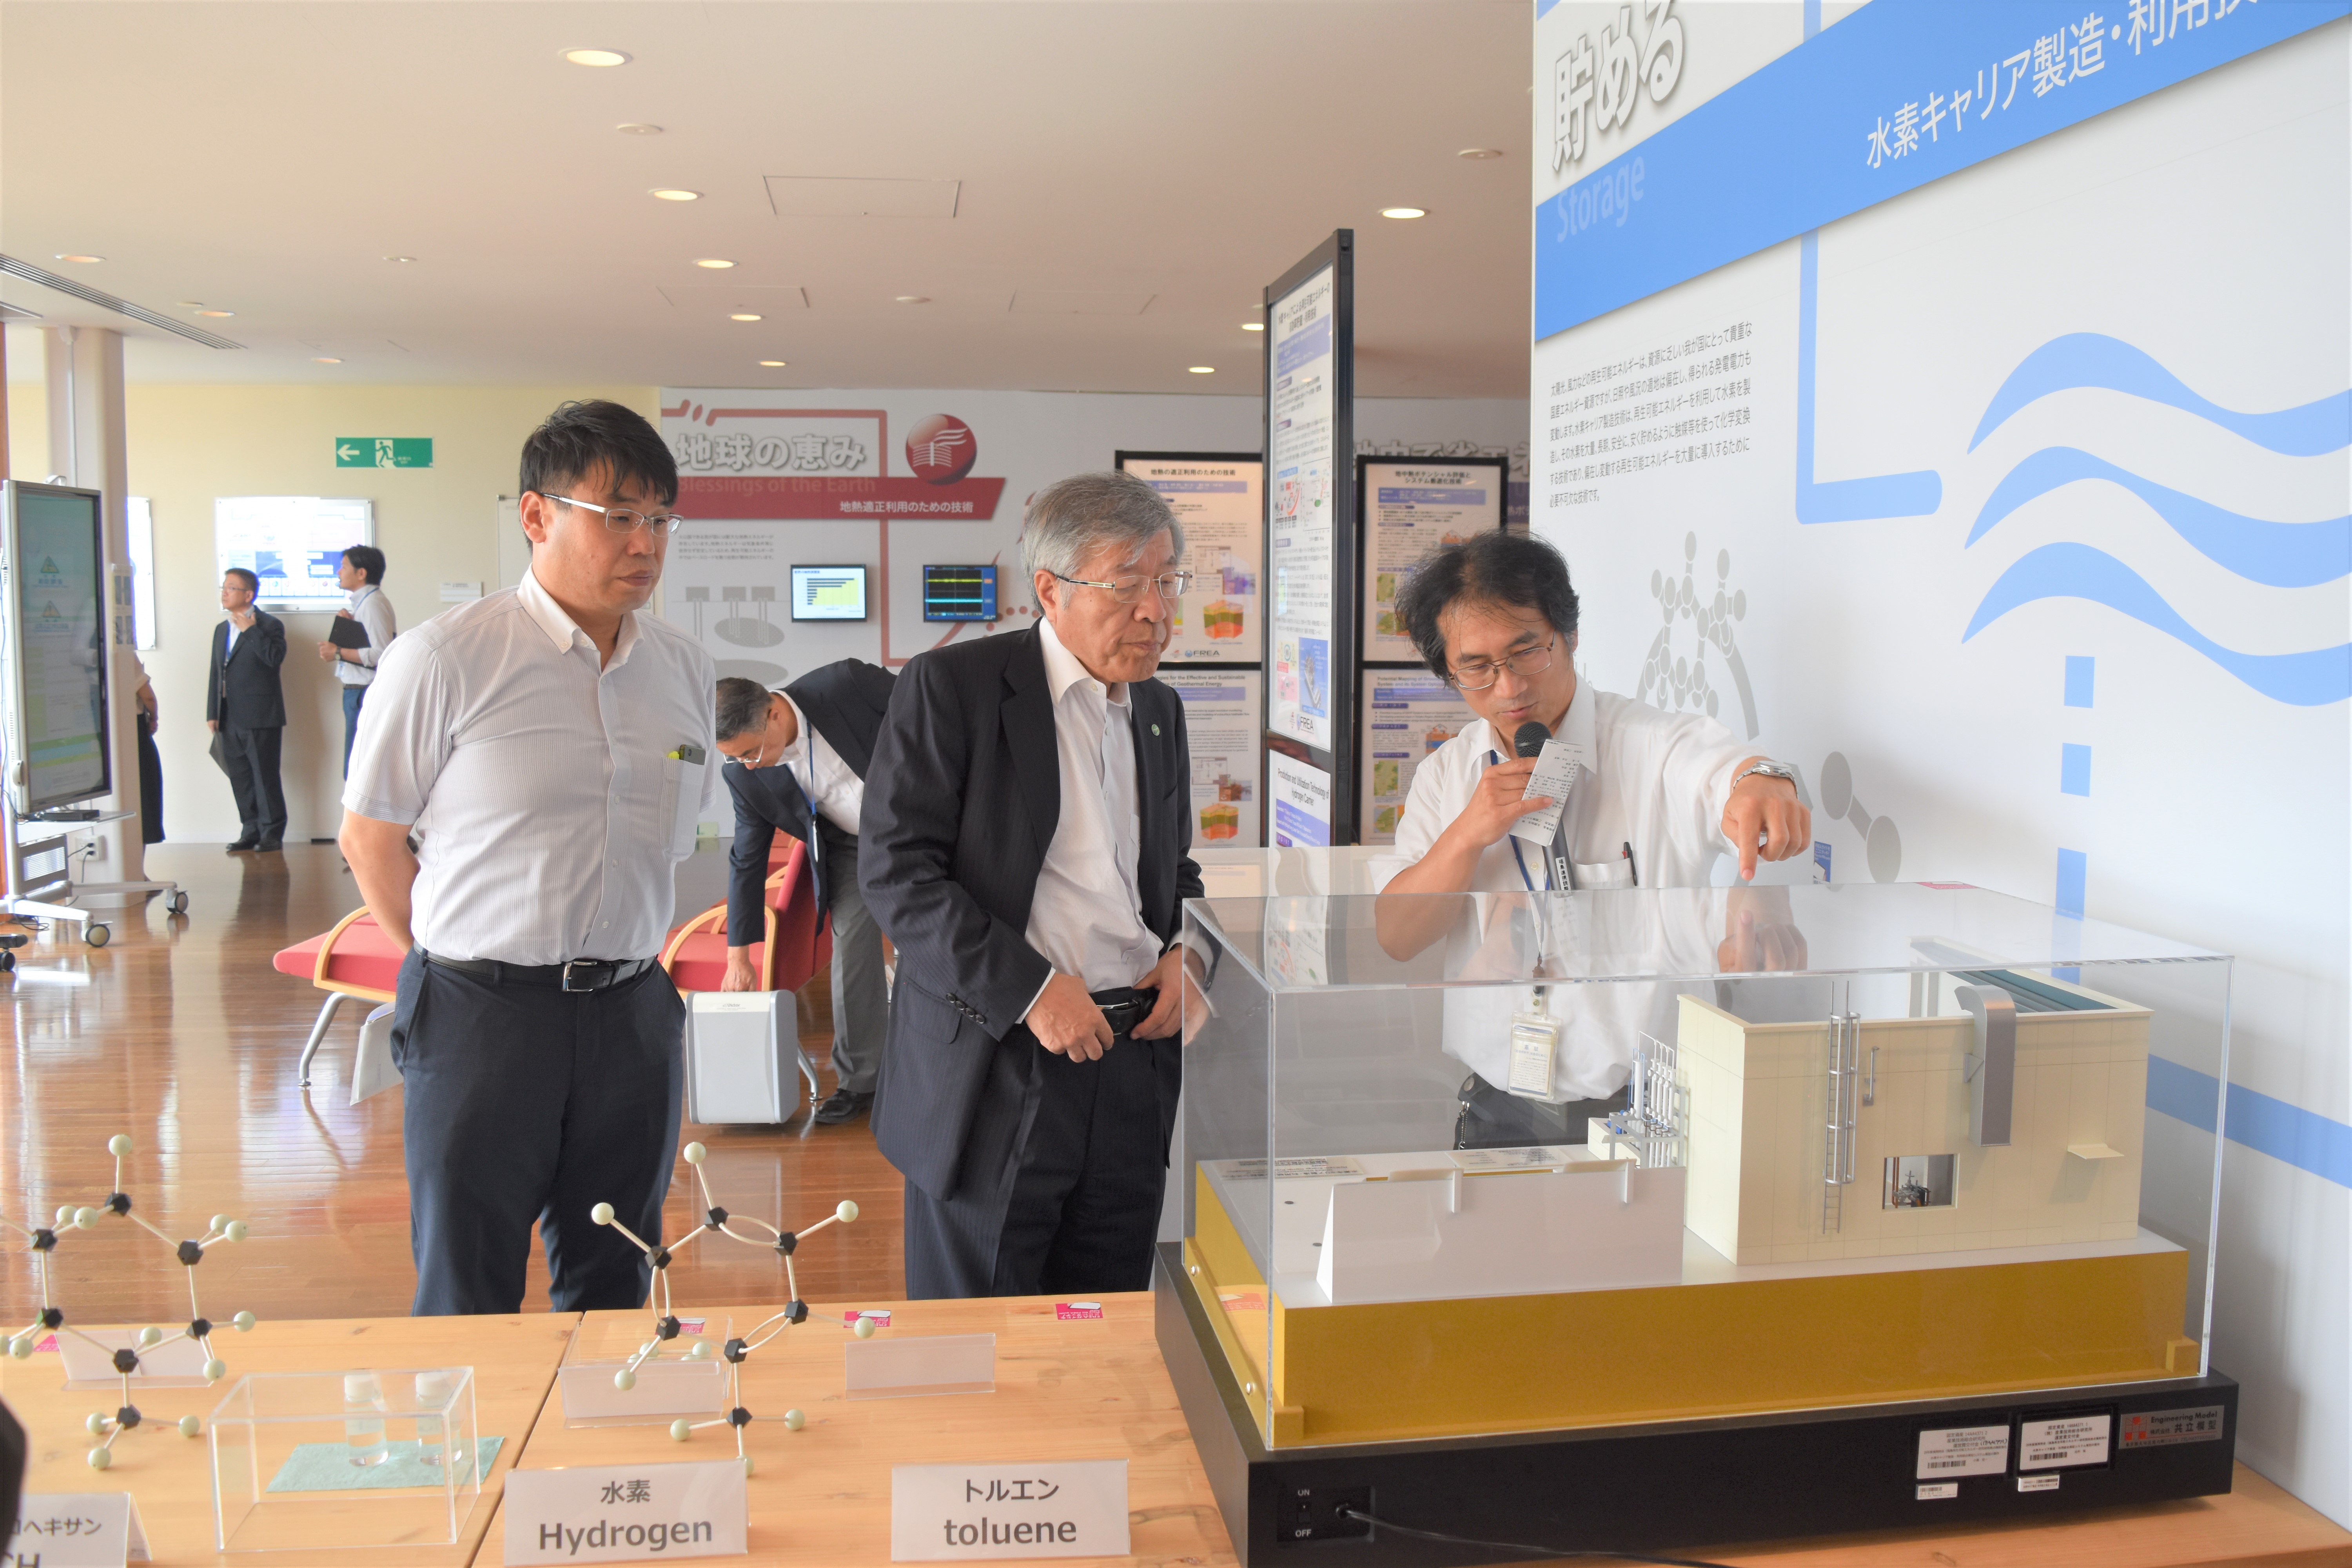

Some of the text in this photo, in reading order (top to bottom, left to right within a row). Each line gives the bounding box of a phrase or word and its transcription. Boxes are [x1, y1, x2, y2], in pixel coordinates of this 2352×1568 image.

[1553, 0, 1683, 172] 貯める
[1557, 156, 1645, 243] Storage
[676, 433, 866, 471] 地球の恵み
[768, 477, 785, 493] of
[791, 477, 821, 493] the
[827, 477, 875, 493] Earth
[839, 501, 974, 514] 地熱適正利用のための技術
[1300, 716, 1314, 731] FREA
[1278, 768, 1291, 782] Production
[1297, 776, 1310, 790] Utilization
[1310, 782, 1326, 800] Technology
[1326, 790, 1329, 799] of
[1292, 787, 1314, 806] Hydrogen Carrier
[2151, 1414, 2193, 1424] Engineering
[2174, 1420, 2216, 1433] 共立模型
[601, 1479, 650, 1504] 水素
[965, 1479, 1060, 1503] トルエン
[539, 1519, 712, 1555] Hydrogen
[944, 1517, 1077, 1546] toluene
[1295, 1529, 1312, 1538] OFF
